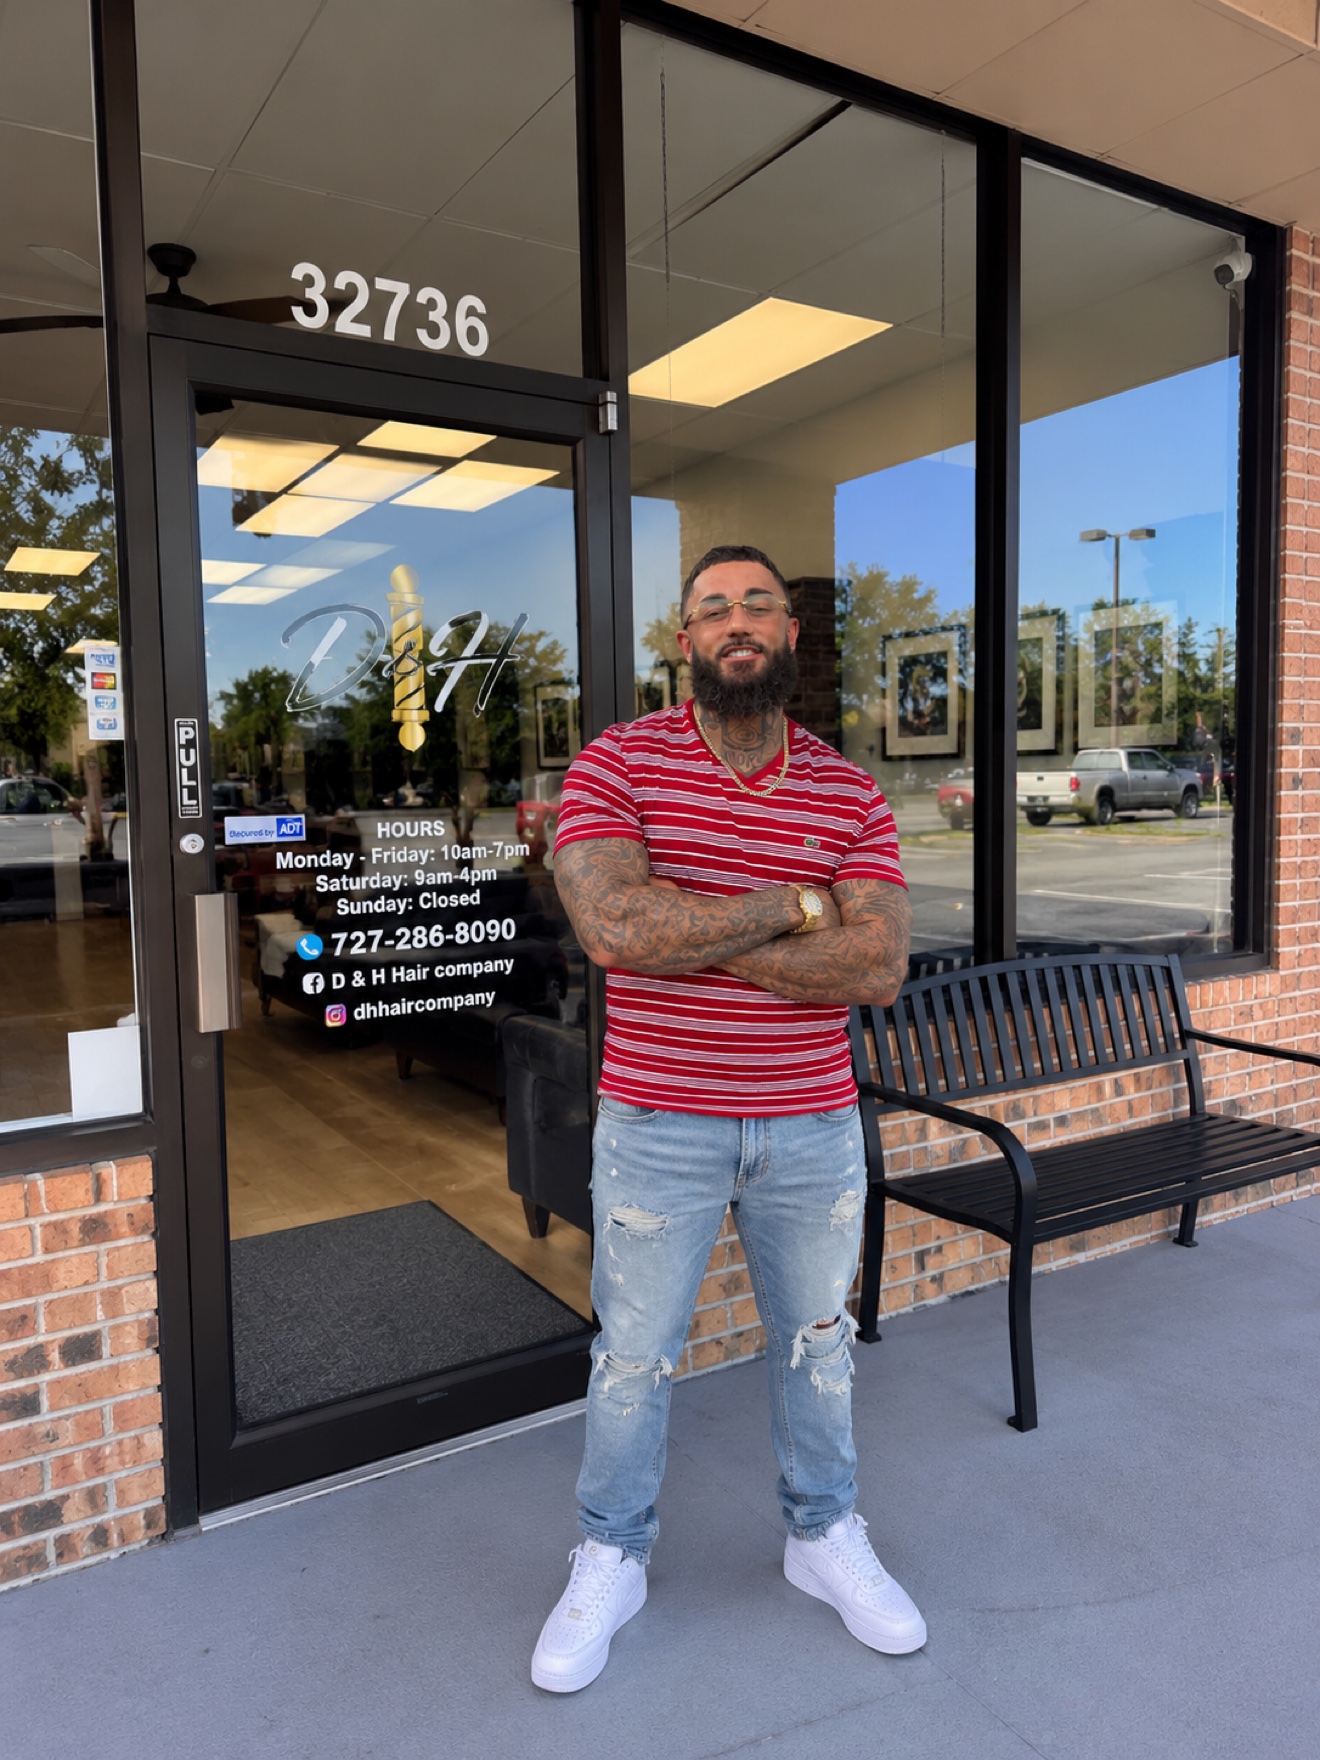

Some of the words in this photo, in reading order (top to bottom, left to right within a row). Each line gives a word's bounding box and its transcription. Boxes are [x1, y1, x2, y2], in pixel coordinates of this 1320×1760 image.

[290, 262, 489, 357] 32736
[179, 727, 197, 805] PULL
[280, 822, 302, 835] ADT
[377, 820, 446, 839] HOURS
[276, 849, 355, 870] Monday
[371, 846, 436, 865] Friday:
[440, 841, 531, 861] 10am-7pm
[315, 872, 408, 893] Saturday:
[414, 866, 498, 887] 9am-4pm
[336, 895, 414, 916] Sunday:
[419, 889, 481, 910] Closed
[331, 918, 516, 956] 727-286-8090
[331, 972, 346, 990] D
[351, 970, 367, 988] &
[371, 967, 386, 986] H
[391, 963, 430, 983] Hair
[433, 958, 515, 980] company
[353, 991, 497, 1021] dhhaircompany
